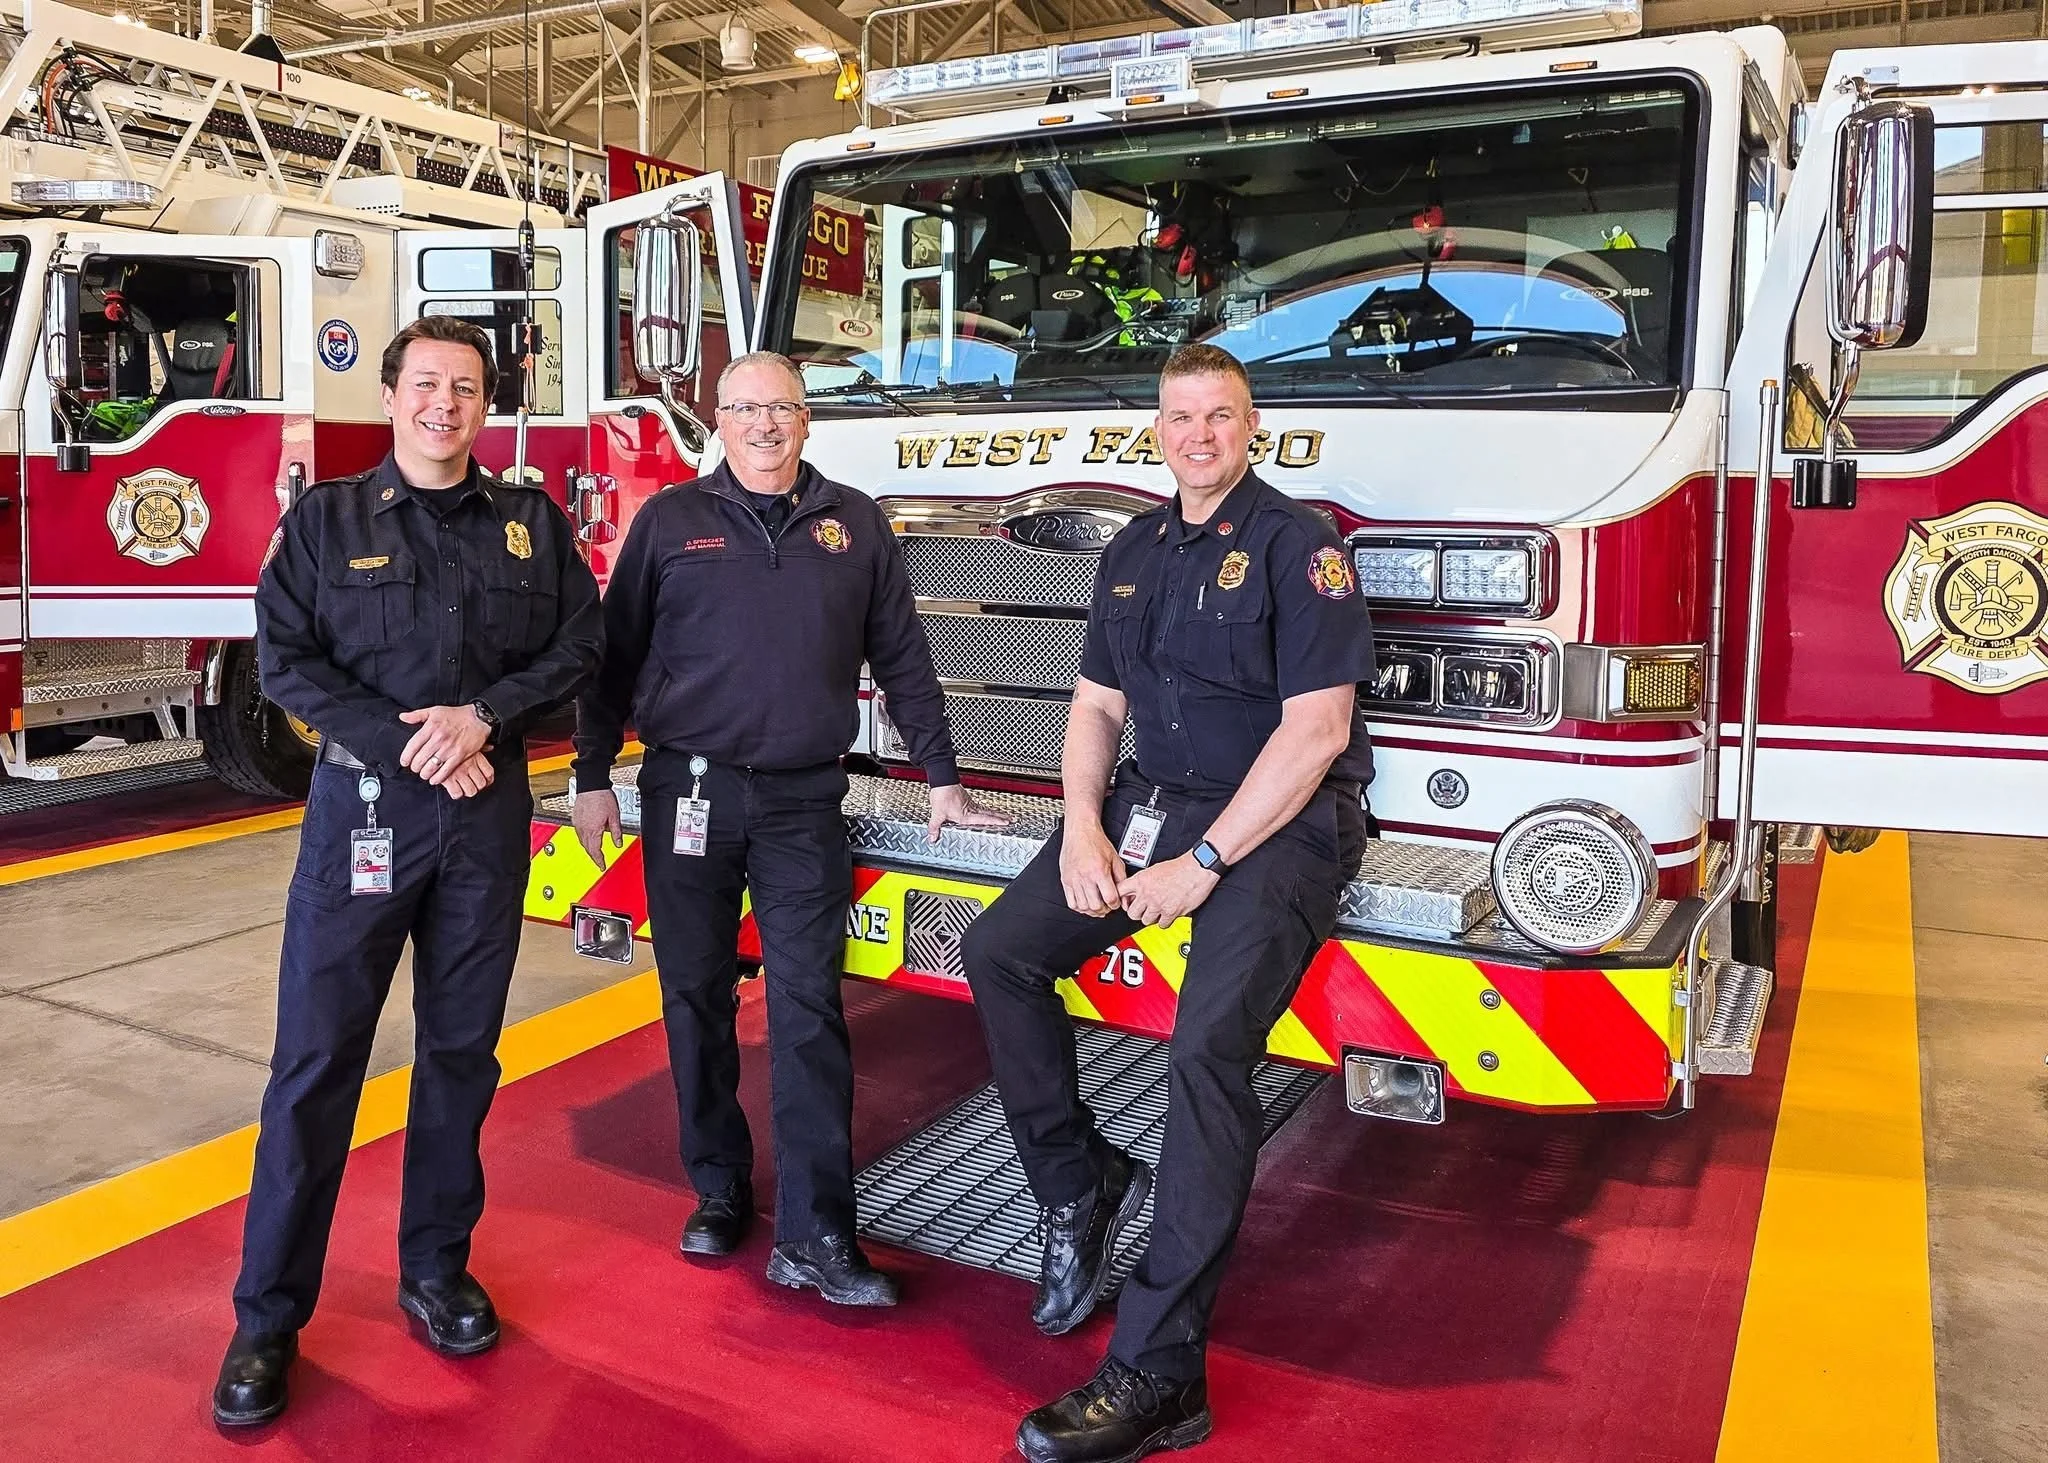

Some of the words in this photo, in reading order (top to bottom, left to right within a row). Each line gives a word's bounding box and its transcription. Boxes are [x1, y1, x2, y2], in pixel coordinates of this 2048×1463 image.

[286, 72, 301, 84] 100
[895, 427, 1067, 469] WEST
[1082, 426, 1325, 469] FAGO
[133, 479, 156, 489] WEST
[158, 479, 185, 491] FARGO
[1030, 515, 1114, 544] Pierce
[1941, 525, 1988, 543] WEST
[1995, 525, 2048, 546] FARGO
[143, 541, 156, 549] FIRE
[1960, 548, 1990, 563] NORTH
[1993, 548, 2024, 565] DAKOTA
[1967, 636, 1987, 647] EST.
[1956, 645, 1983, 659] FIRE
[1988, 648, 2024, 659] DEPT.
[1099, 944, 1144, 988] 76
